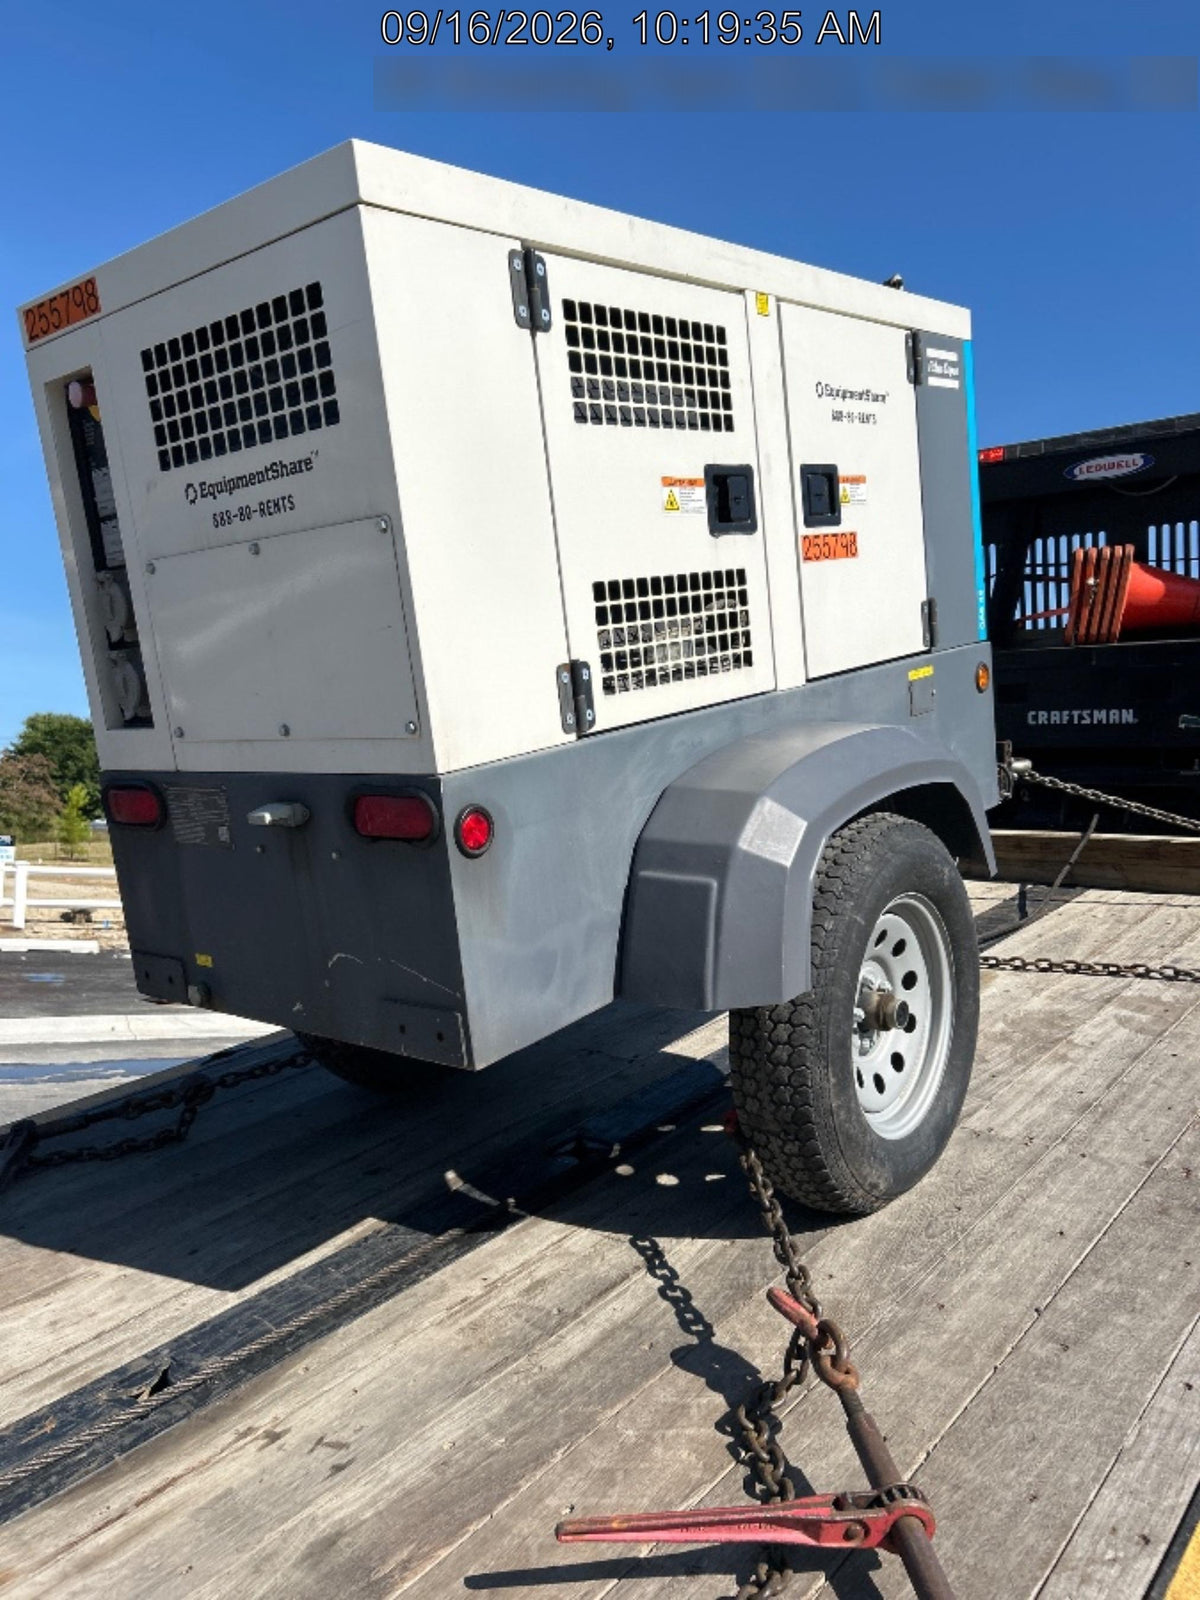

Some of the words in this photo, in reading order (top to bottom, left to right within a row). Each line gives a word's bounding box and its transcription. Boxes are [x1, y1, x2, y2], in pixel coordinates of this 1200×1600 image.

[25, 280, 99, 342] 255798
[199, 457, 314, 500] EquipmentShare
[1079, 458, 1139, 475] LEDWELL
[803, 532, 857, 561] 255798
[1027, 708, 1134, 725] CRAFTSMAN
